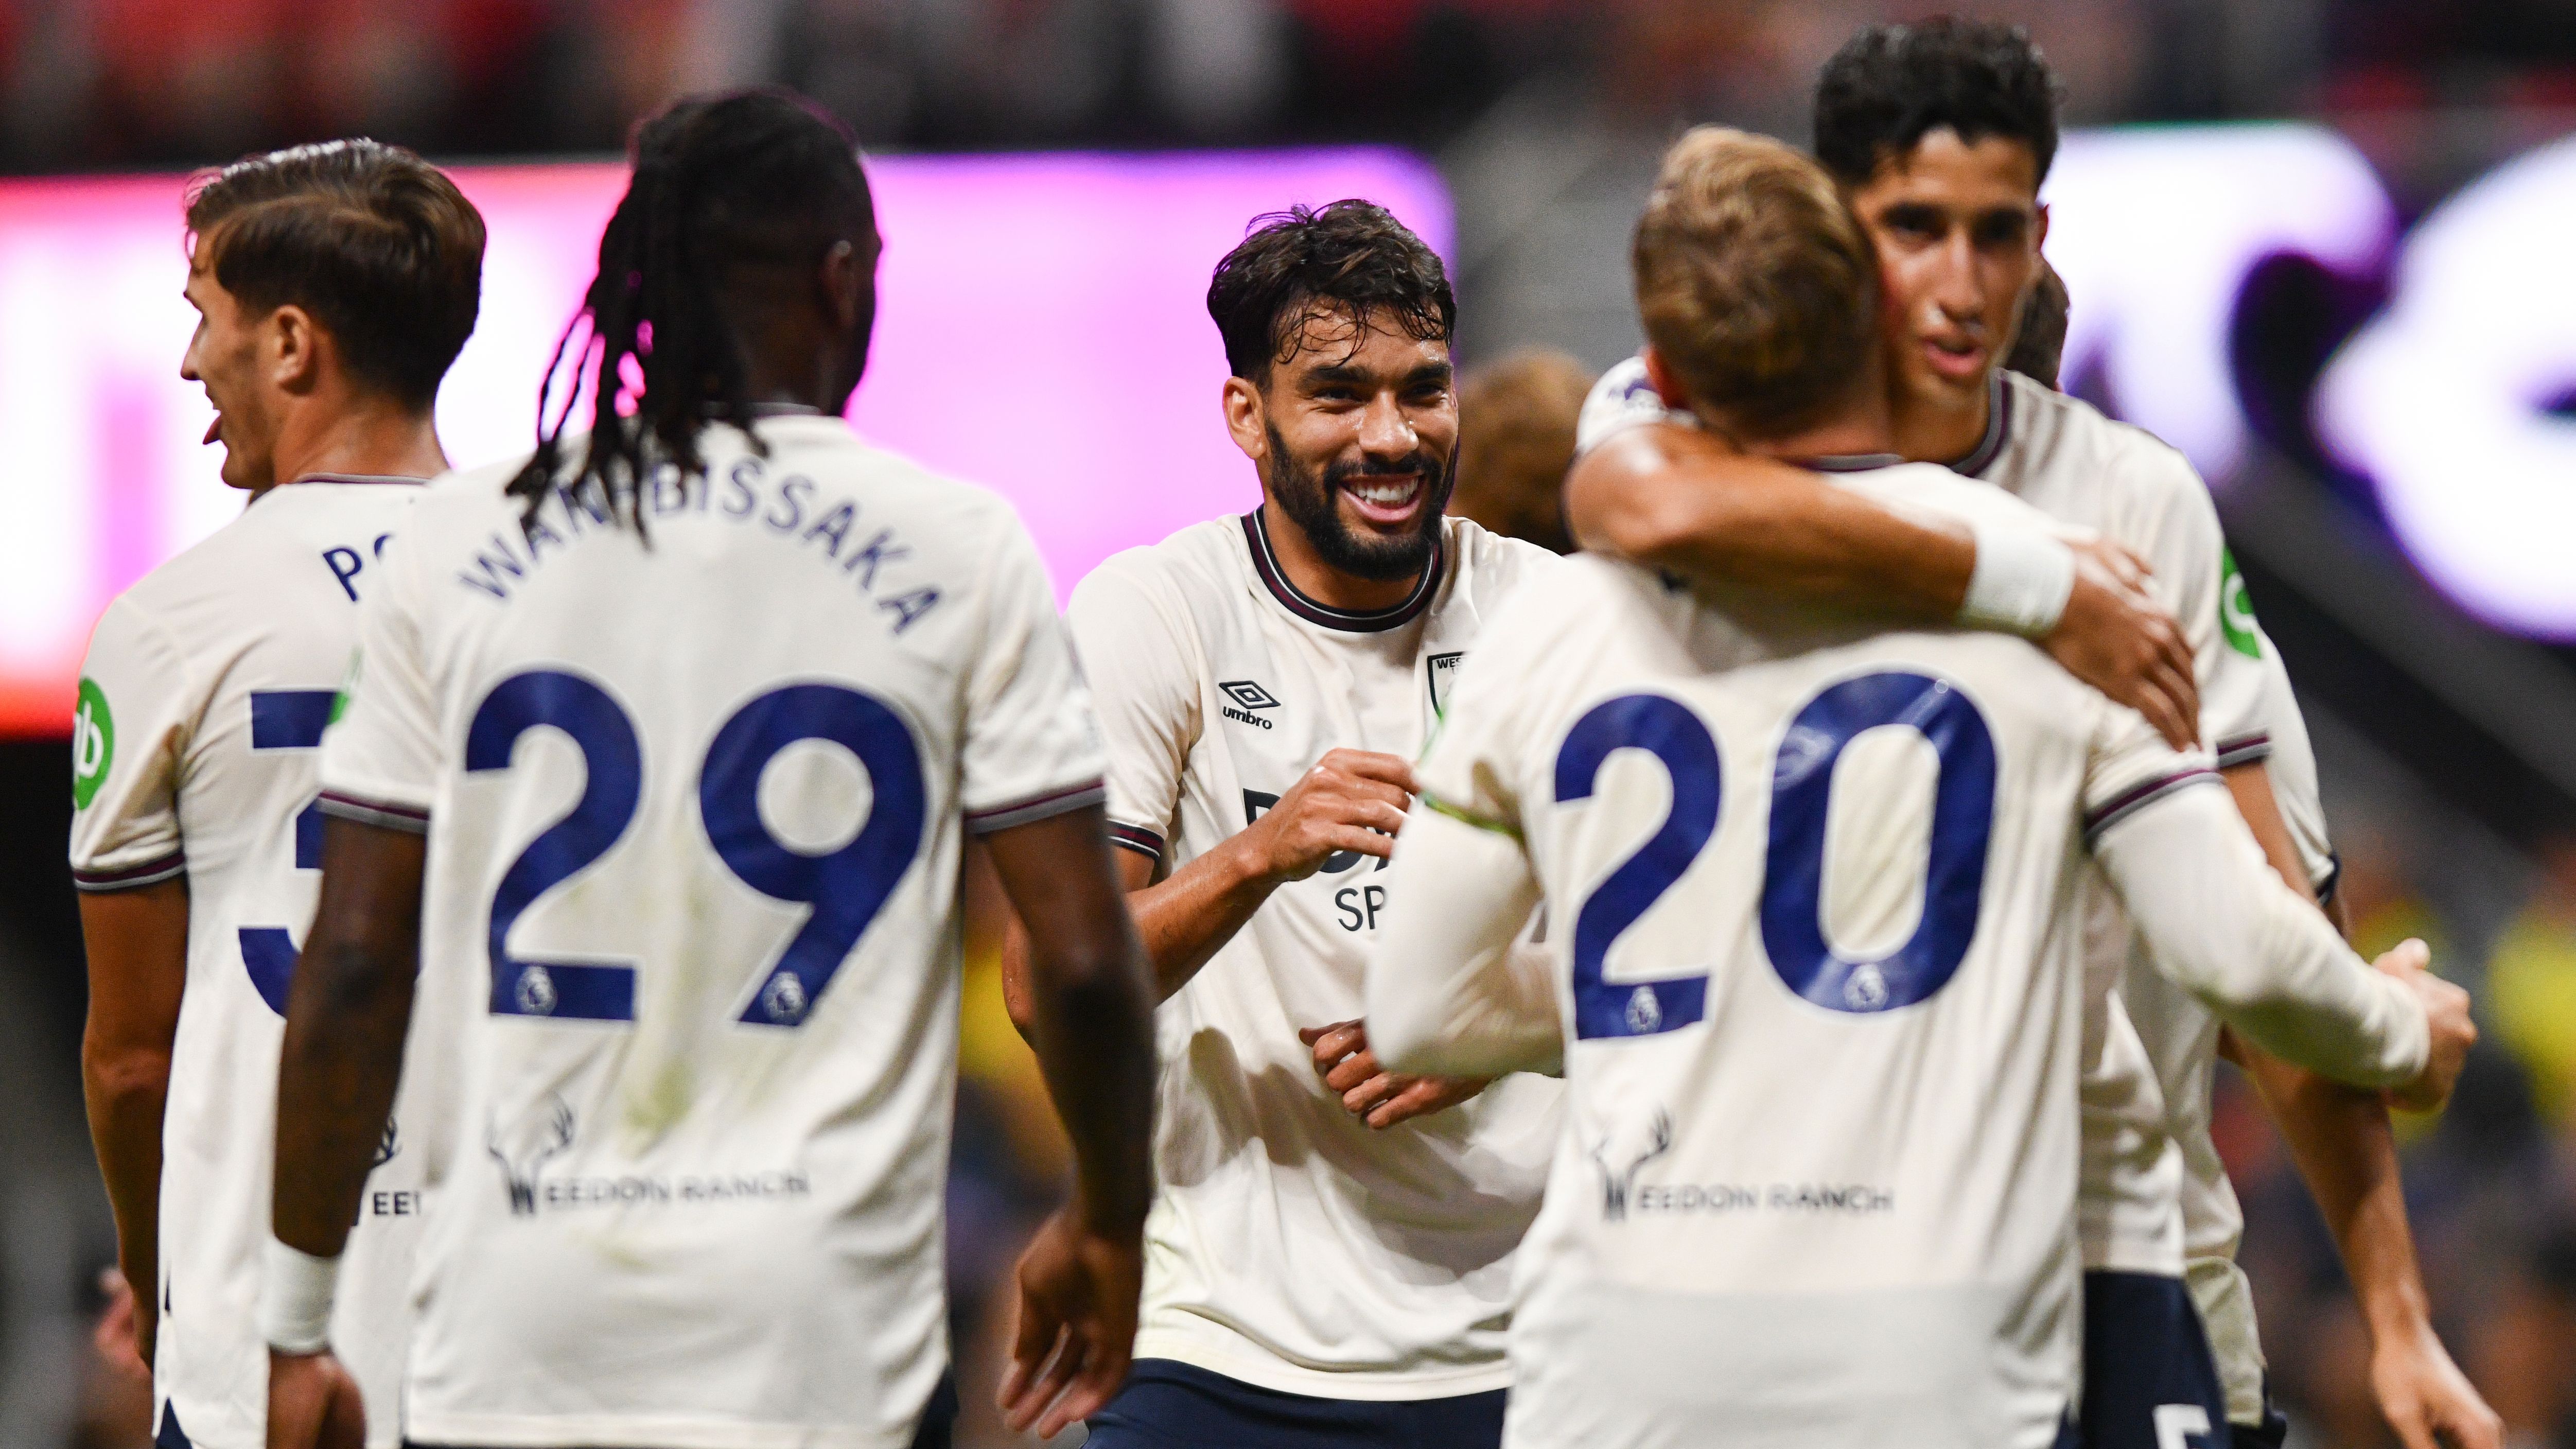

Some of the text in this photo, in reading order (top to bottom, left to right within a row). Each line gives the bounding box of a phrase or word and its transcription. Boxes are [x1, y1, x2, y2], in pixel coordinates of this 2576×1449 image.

[466, 670, 924, 1026] 29
[1223, 706, 1272, 729] umbro
[1555, 672, 1995, 1040] 20
